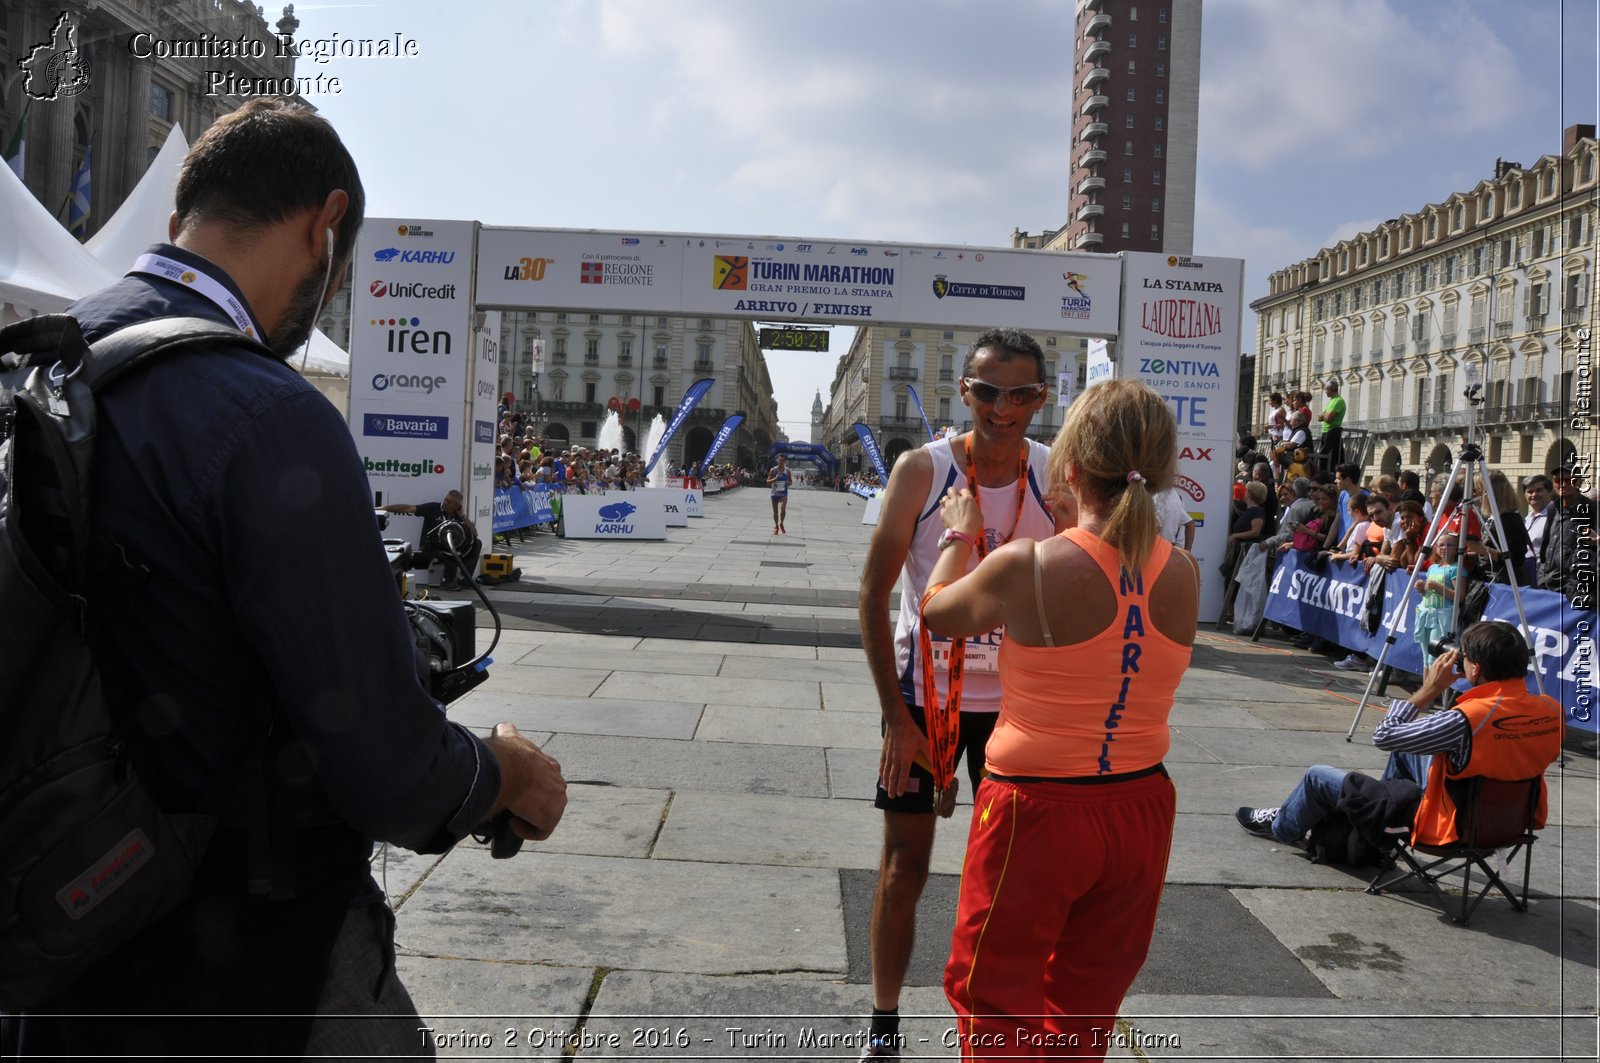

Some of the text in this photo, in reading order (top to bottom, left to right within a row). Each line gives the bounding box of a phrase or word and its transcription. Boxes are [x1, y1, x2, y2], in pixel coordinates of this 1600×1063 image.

[400, 250, 455, 264] KARHU
[582, 252, 595, 260] Con
[601, 254, 632, 264] patrocinio
[604, 263, 653, 276] REGIONE
[752, 261, 894, 285] TURIN MARATHON
[604, 276, 653, 286] PIEMONTE
[1143, 278, 1223, 292] LA STAMPA
[389, 282, 456, 300] UniCredit
[751, 283, 893, 298] GRAN PREMIO LA STAMPA
[735, 299, 872, 316] ARRIVO / FINISH
[1062, 298, 1091, 307] TURIN
[1142, 300, 1222, 338] LAURETANA
[387, 329, 451, 355] iren
[1140, 378, 1220, 390] RUPPO SANOFI
[386, 418, 438, 432] Bavaria
[594, 523, 635, 534] KARHU
